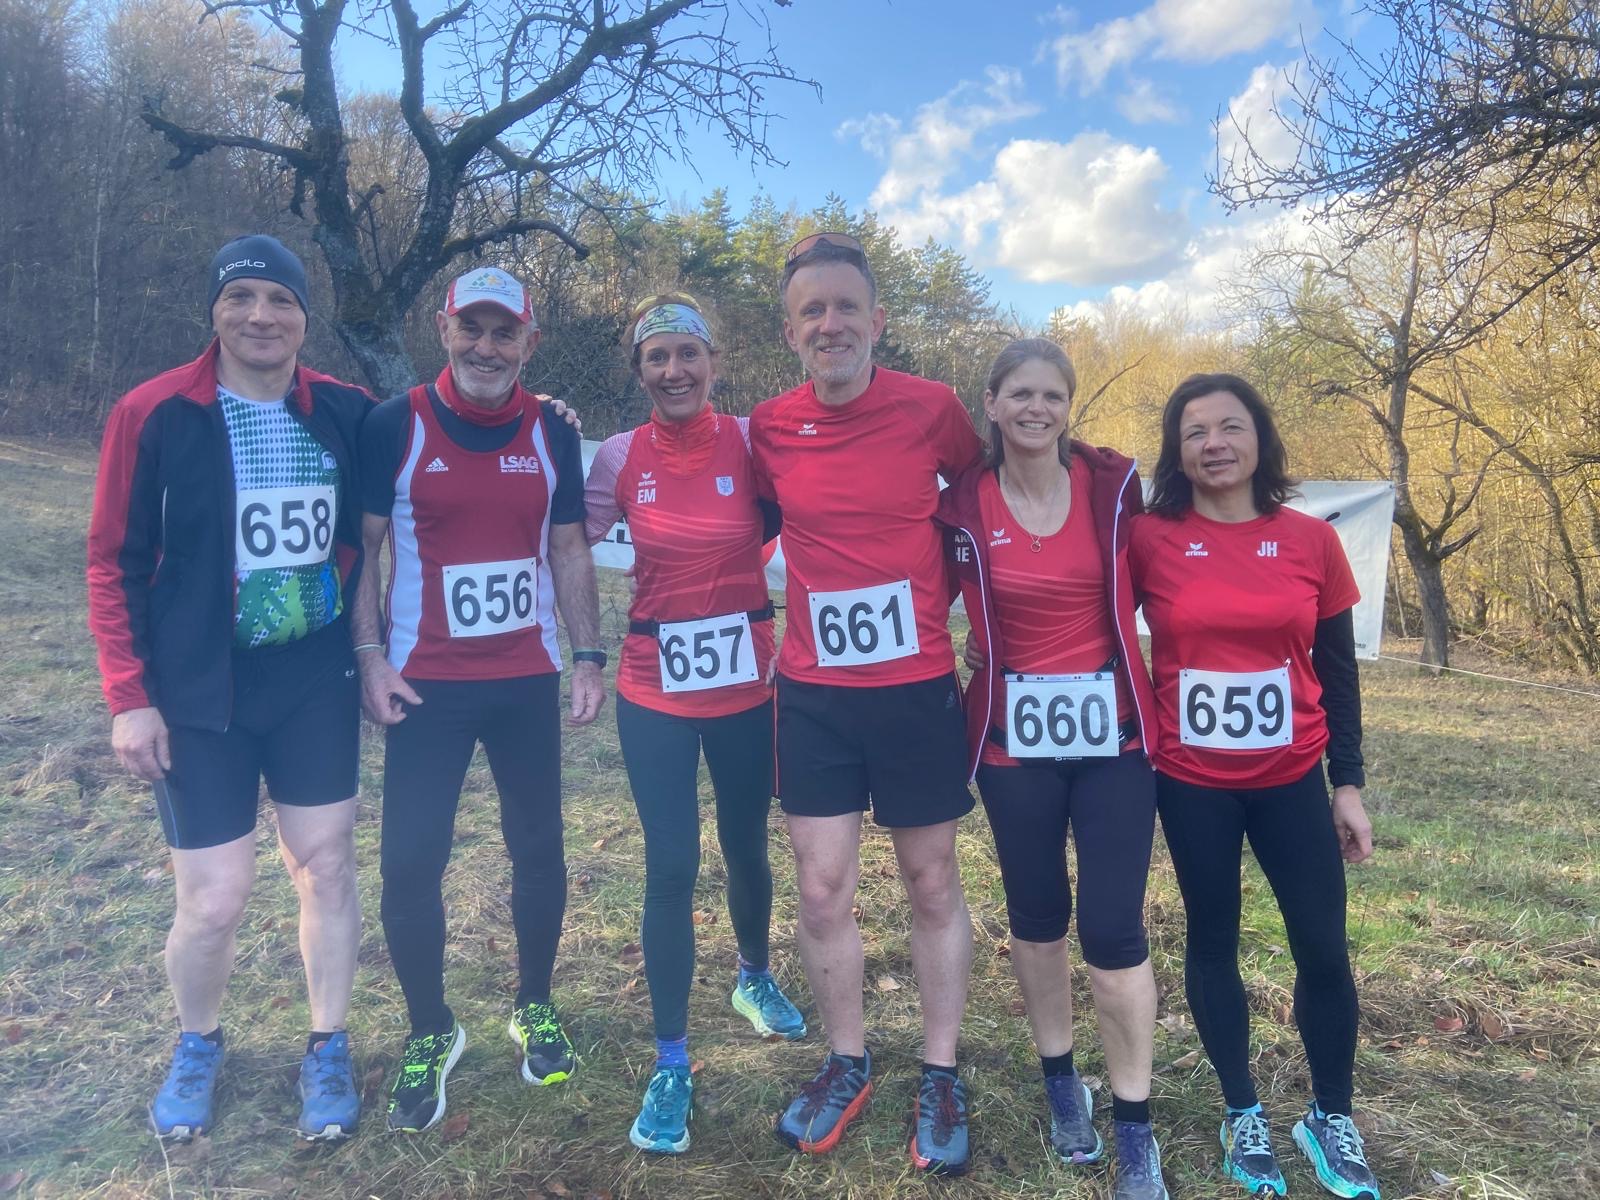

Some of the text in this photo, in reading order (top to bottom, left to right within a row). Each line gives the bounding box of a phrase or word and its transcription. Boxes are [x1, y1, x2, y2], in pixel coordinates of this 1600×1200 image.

[226, 259, 266, 271] odlo
[499, 455, 539, 469] LSAG
[637, 488, 656, 504] EM
[241, 499, 330, 557] 658
[1257, 541, 1277, 557] JH
[452, 571, 531, 626] 656
[819, 595, 904, 655] 661
[661, 625, 743, 682] 657
[1014, 693, 1109, 747] 660
[1187, 683, 1284, 741] 659
